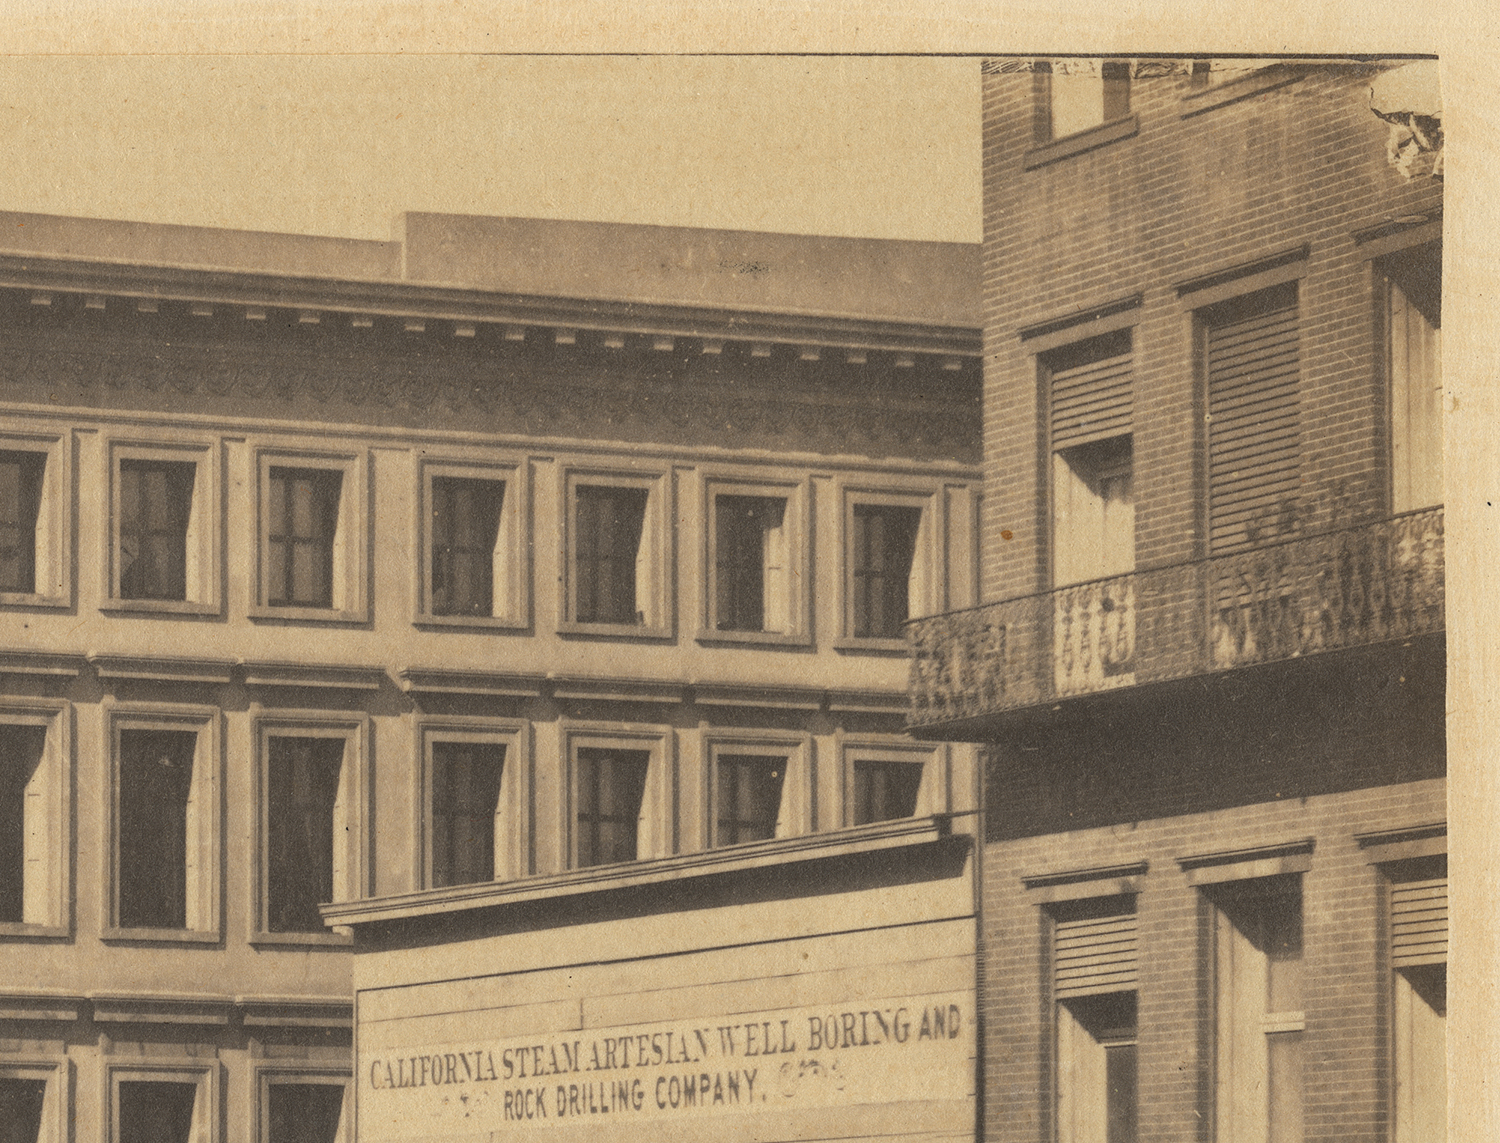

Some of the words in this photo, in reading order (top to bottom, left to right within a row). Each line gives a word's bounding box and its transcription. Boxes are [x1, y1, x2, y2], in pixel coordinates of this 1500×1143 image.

[369, 1049, 498, 1090] CALIFORNIA
[503, 1040, 581, 1080] STEAM
[585, 1027, 710, 1072] ARTESIAN
[716, 1019, 796, 1057] WELL
[807, 1006, 911, 1052] BORING
[918, 1003, 962, 1042] AND
[503, 1087, 548, 1121] ROCK
[556, 1078, 645, 1117] DRILLING
[654, 1068, 767, 1110] COMPANY.
